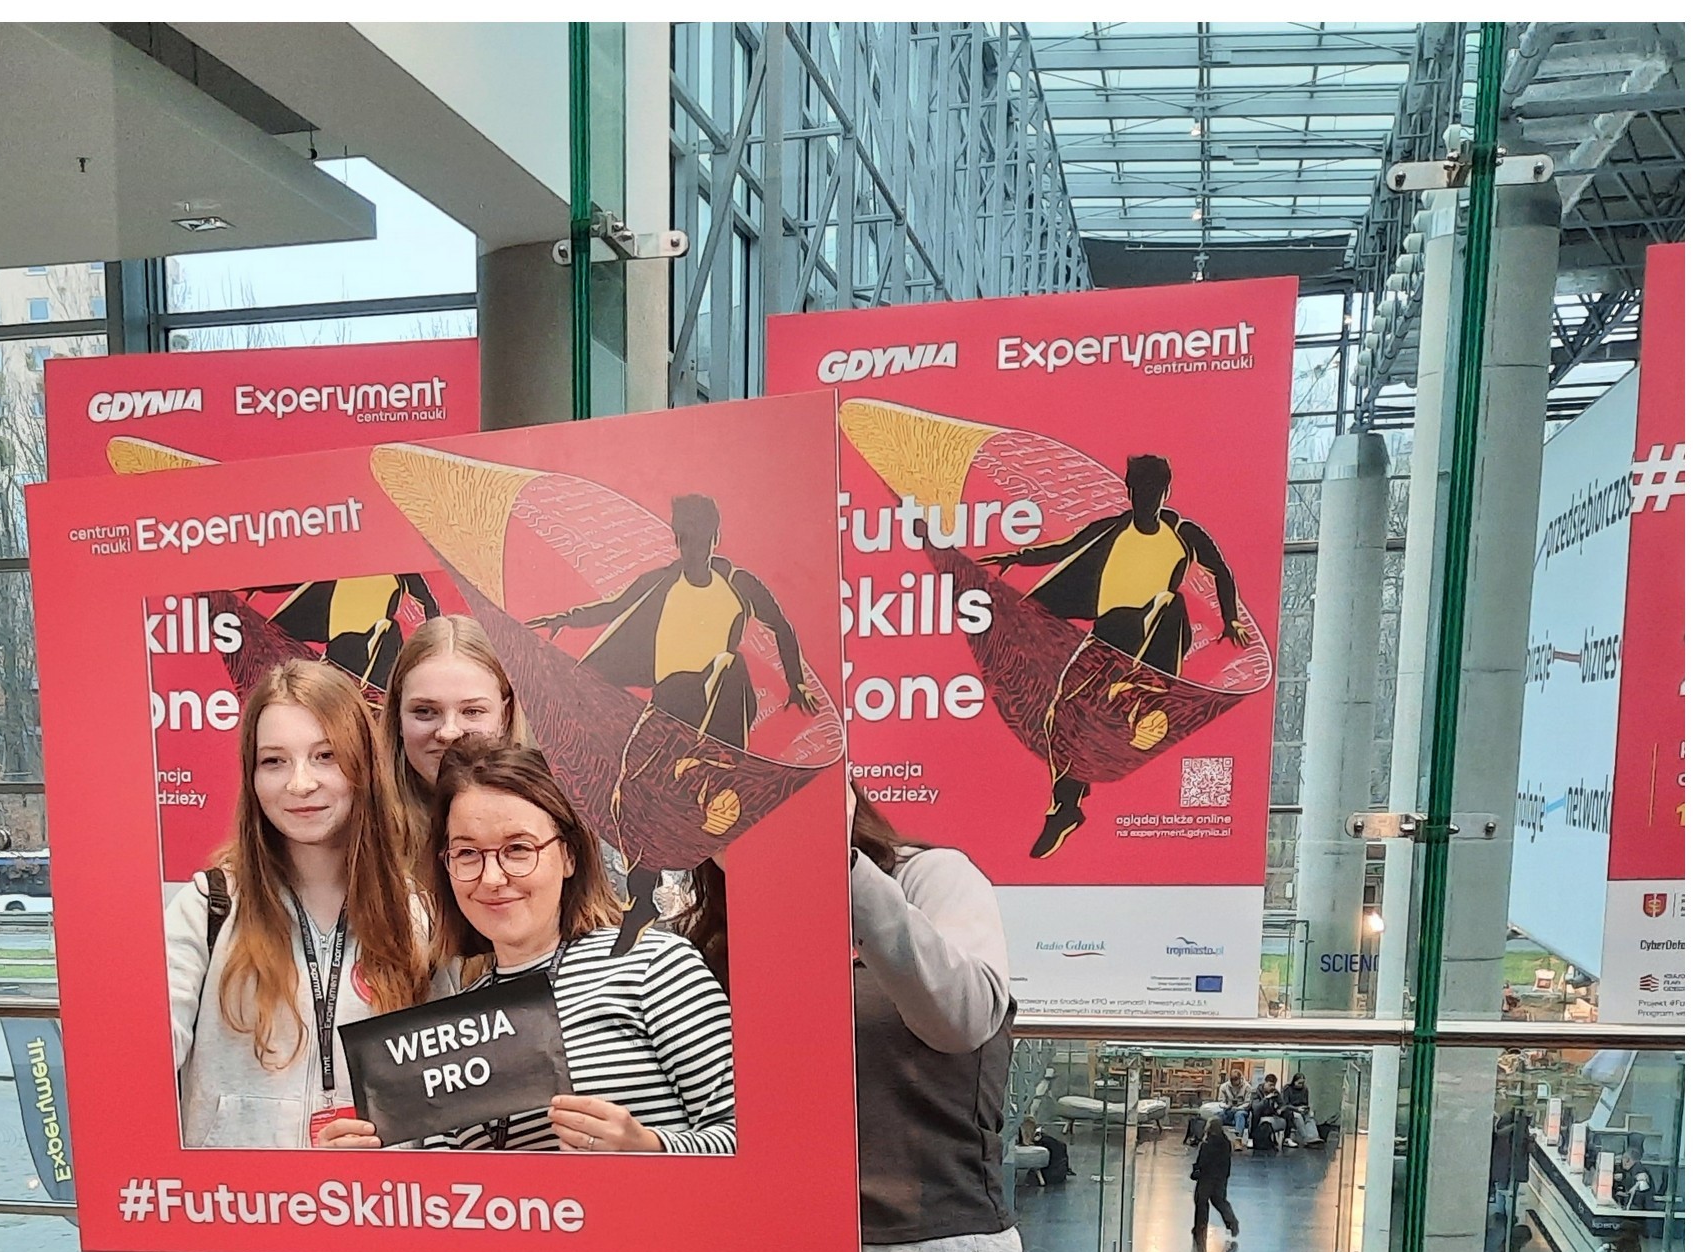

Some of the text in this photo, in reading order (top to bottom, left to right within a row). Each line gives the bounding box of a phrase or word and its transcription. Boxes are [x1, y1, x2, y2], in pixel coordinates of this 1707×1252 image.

[817, 320, 1256, 383] GDYNIA Experyment
[1143, 354, 1255, 375] centrum nauki
[87, 376, 447, 422] GDYNIA Experyment
[356, 407, 446, 423] centrum nauki
[69, 524, 131, 541] centrum
[91, 537, 132, 554] nauki
[136, 497, 363, 553] Experyment
[844, 662, 985, 721] one
[1116, 814, 1232, 826] oglądaj także online
[1566, 774, 1611, 834] network
[1065, 939, 1106, 951] Gdańsk
[385, 1009, 516, 1065] WERSJA
[423, 1057, 491, 1098] PRO
[27, 1037, 73, 1182] Experyment
[119, 1178, 586, 1233] #FutureSkillsZone
